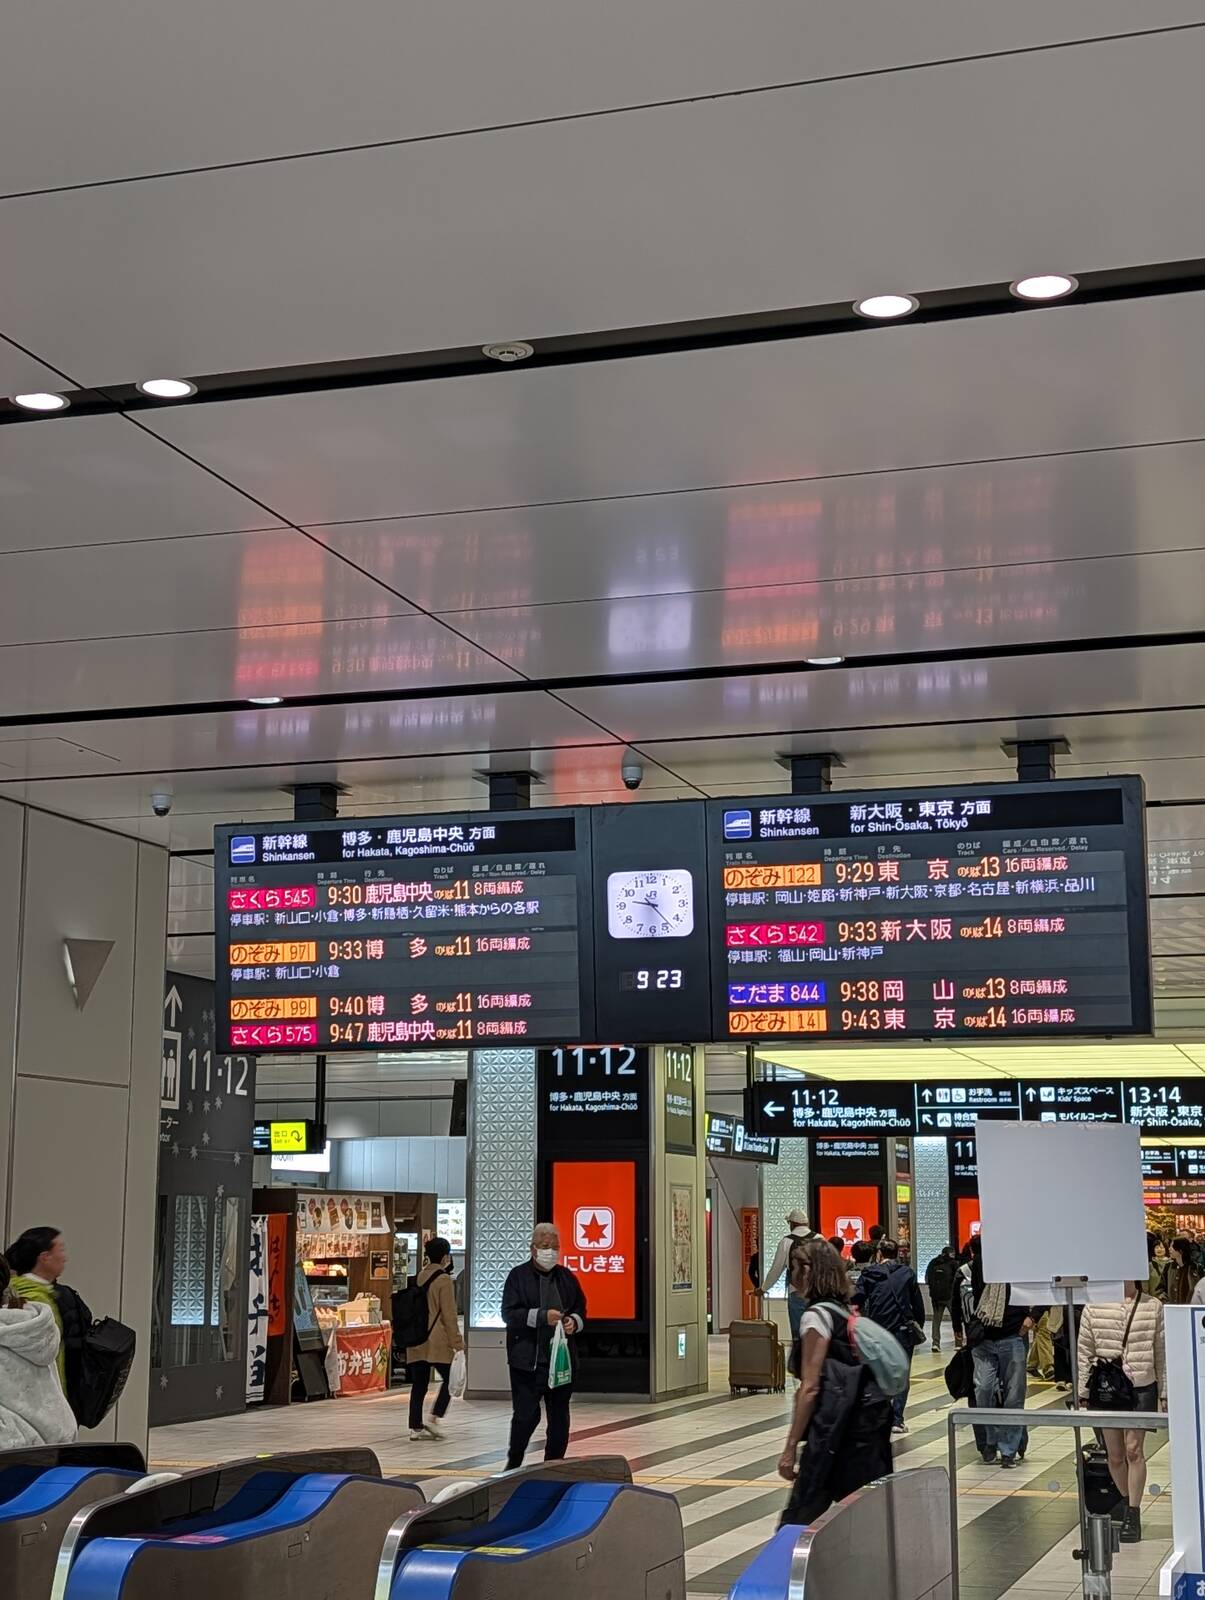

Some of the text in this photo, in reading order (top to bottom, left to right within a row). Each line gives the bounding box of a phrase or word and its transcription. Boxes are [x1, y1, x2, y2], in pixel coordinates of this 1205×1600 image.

[760, 808, 811, 826] 新幹線
[850, 800, 991, 821] 新大阪・東京 方面
[760, 826, 820, 838] Shinkansen
[850, 818, 968, 833] for Shin-Ōsaka, Tōkyō
[262, 834, 308, 850] 新幹線
[342, 826, 496, 846] 博多・鹿児島中央 方面
[262, 852, 315, 862] Shinkansen
[342, 848, 355, 858] for
[357, 847, 393, 858] Hakata,
[646, 876, 656, 884] 12
[725, 868, 781, 887] のぞみ
[836, 862, 874, 884] 9:29
[634, 880, 644, 888] 11
[672, 886, 680, 894] 2
[231, 890, 280, 908] さくら
[328, 885, 362, 905] 9:30
[364, 882, 433, 904] 鹿児島中央
[624, 889, 635, 897] 10
[646, 890, 657, 898] JR
[618, 902, 626, 910] 9
[626, 916, 632, 924] 8
[673, 914, 680, 922] 4
[636, 924, 644, 932] 7
[649, 926, 656, 934] 6
[662, 922, 669, 931] 5
[728, 926, 784, 944] さくら
[838, 921, 877, 942] 9:33
[231, 946, 280, 963] のぞみ
[329, 940, 362, 960] 9:33
[730, 984, 785, 1004] こだま
[840, 980, 879, 1002] 9:38
[232, 1001, 282, 1018] のぞみ
[330, 996, 364, 1016] 9:40
[730, 1013, 786, 1032] のぞみ
[842, 1010, 880, 1030] 9:43
[232, 1027, 282, 1044] さくら
[330, 1023, 364, 1042] 9:47
[367, 1020, 436, 1042] 鹿児島中央
[1128, 1086, 1182, 1104] 13・14
[793, 1118, 806, 1127] for
[808, 1118, 839, 1128] Hakata,
[564, 1255, 624, 1274] にしき堂
